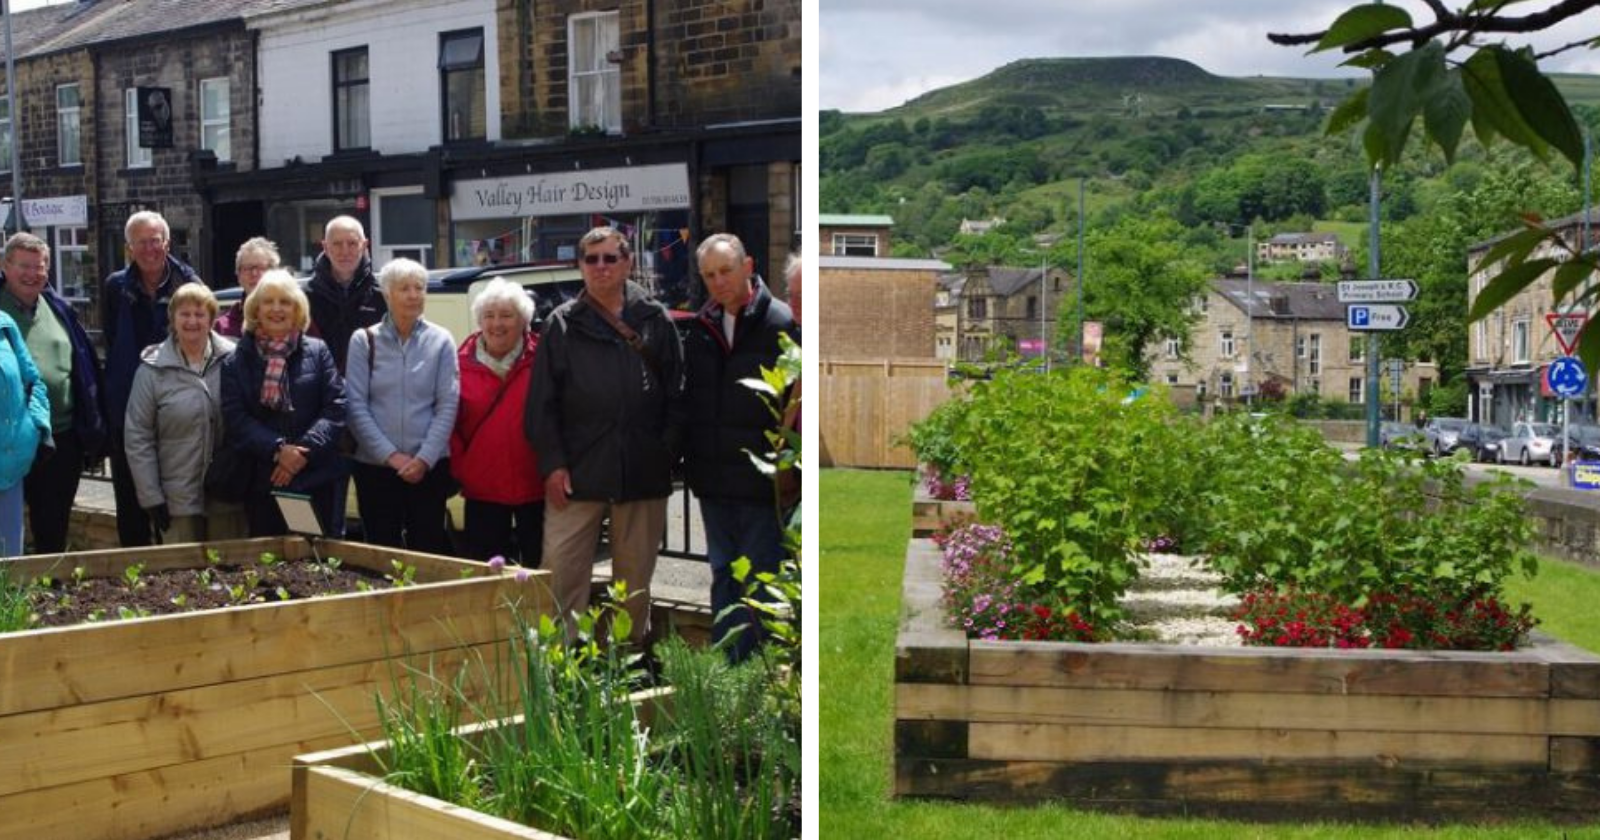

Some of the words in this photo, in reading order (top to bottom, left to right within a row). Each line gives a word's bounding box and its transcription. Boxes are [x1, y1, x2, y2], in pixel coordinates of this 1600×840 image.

[475, 185, 522, 214] Valley
[527, 179, 567, 204] Hair
[570, 180, 630, 210] Design
[1356, 310, 1367, 324] P
[1372, 312, 1391, 322] Free
